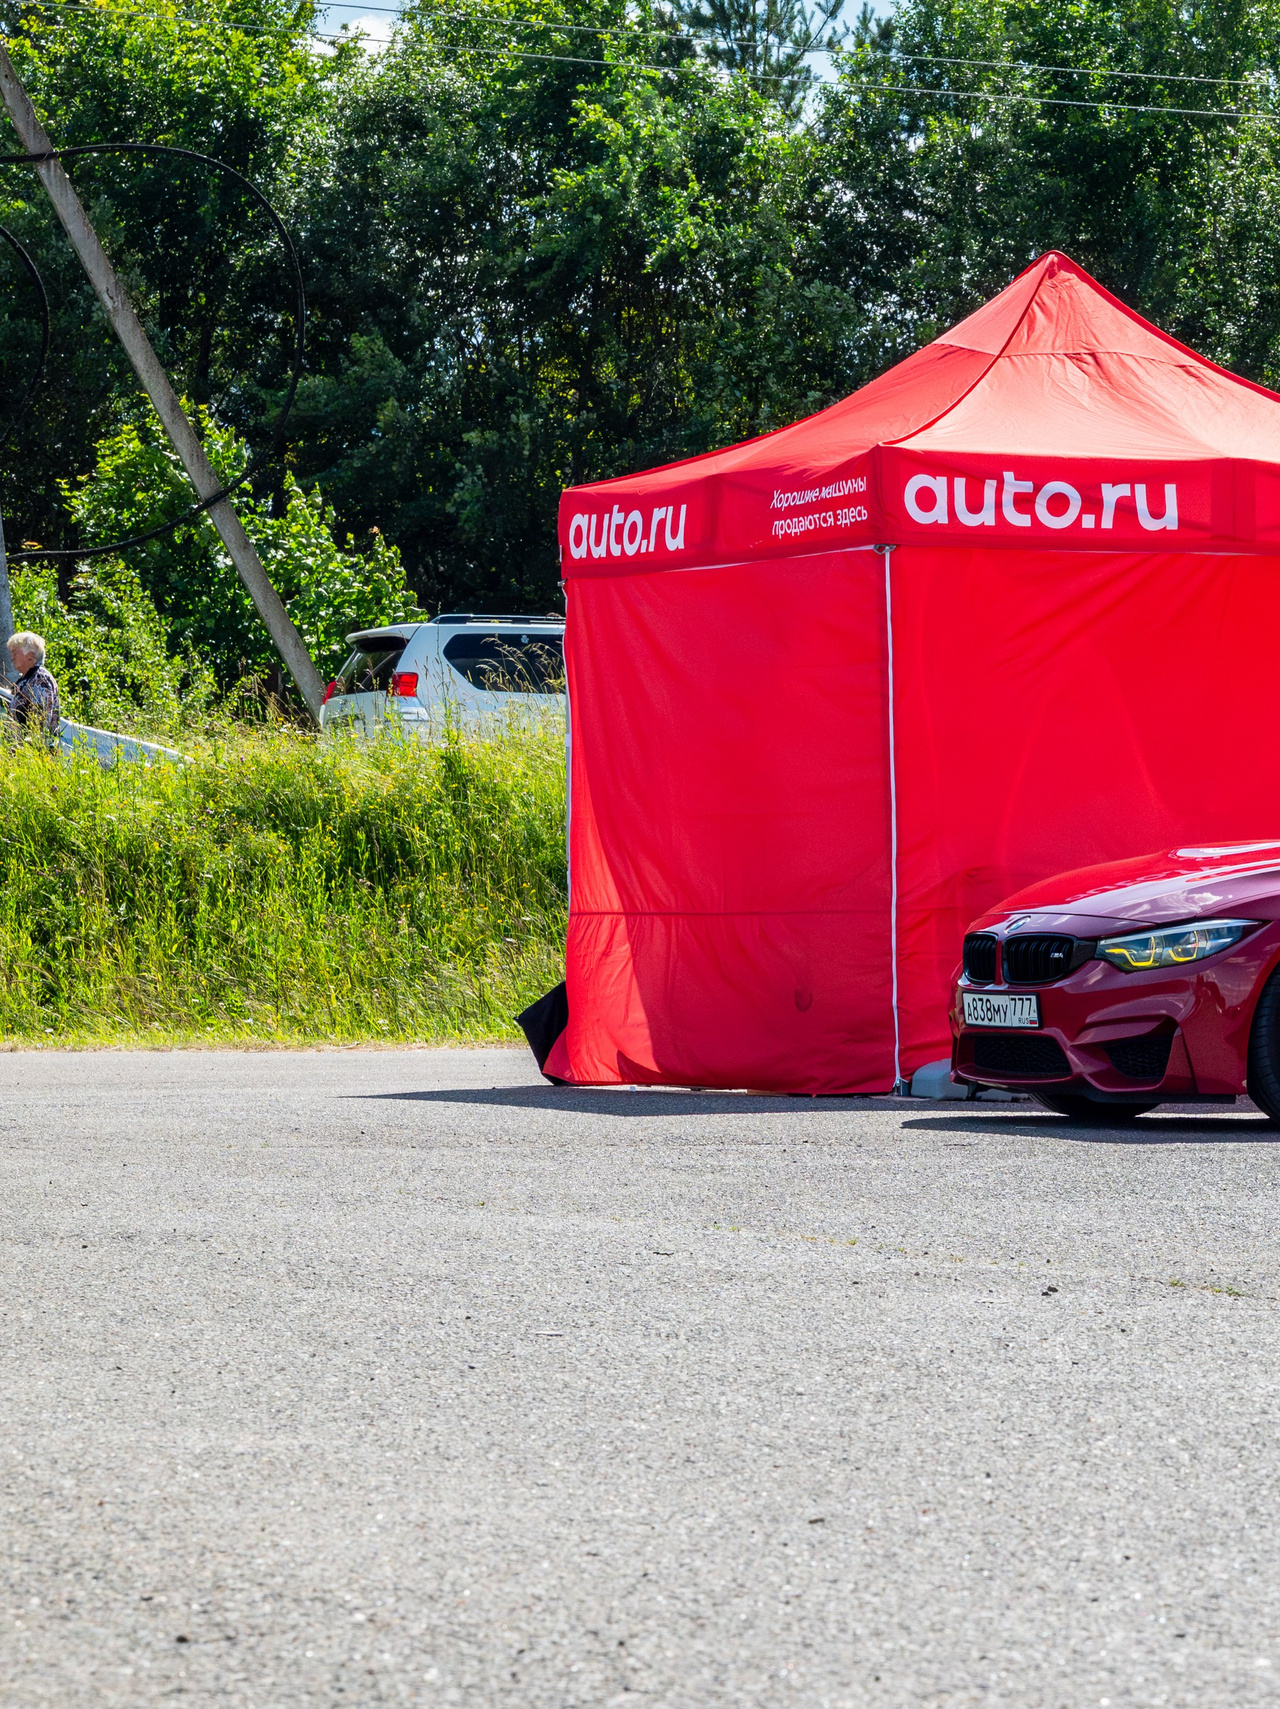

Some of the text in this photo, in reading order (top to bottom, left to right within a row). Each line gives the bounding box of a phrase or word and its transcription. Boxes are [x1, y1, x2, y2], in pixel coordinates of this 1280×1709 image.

[770, 476, 867, 512] Хорошие машины
[904, 472, 1178, 531] auto.ru
[569, 504, 687, 560] auto.ru
[772, 505, 868, 539] продаются здесь
[1010, 997, 1032, 1016] 777
[1018, 1017, 1030, 1025] RUS
